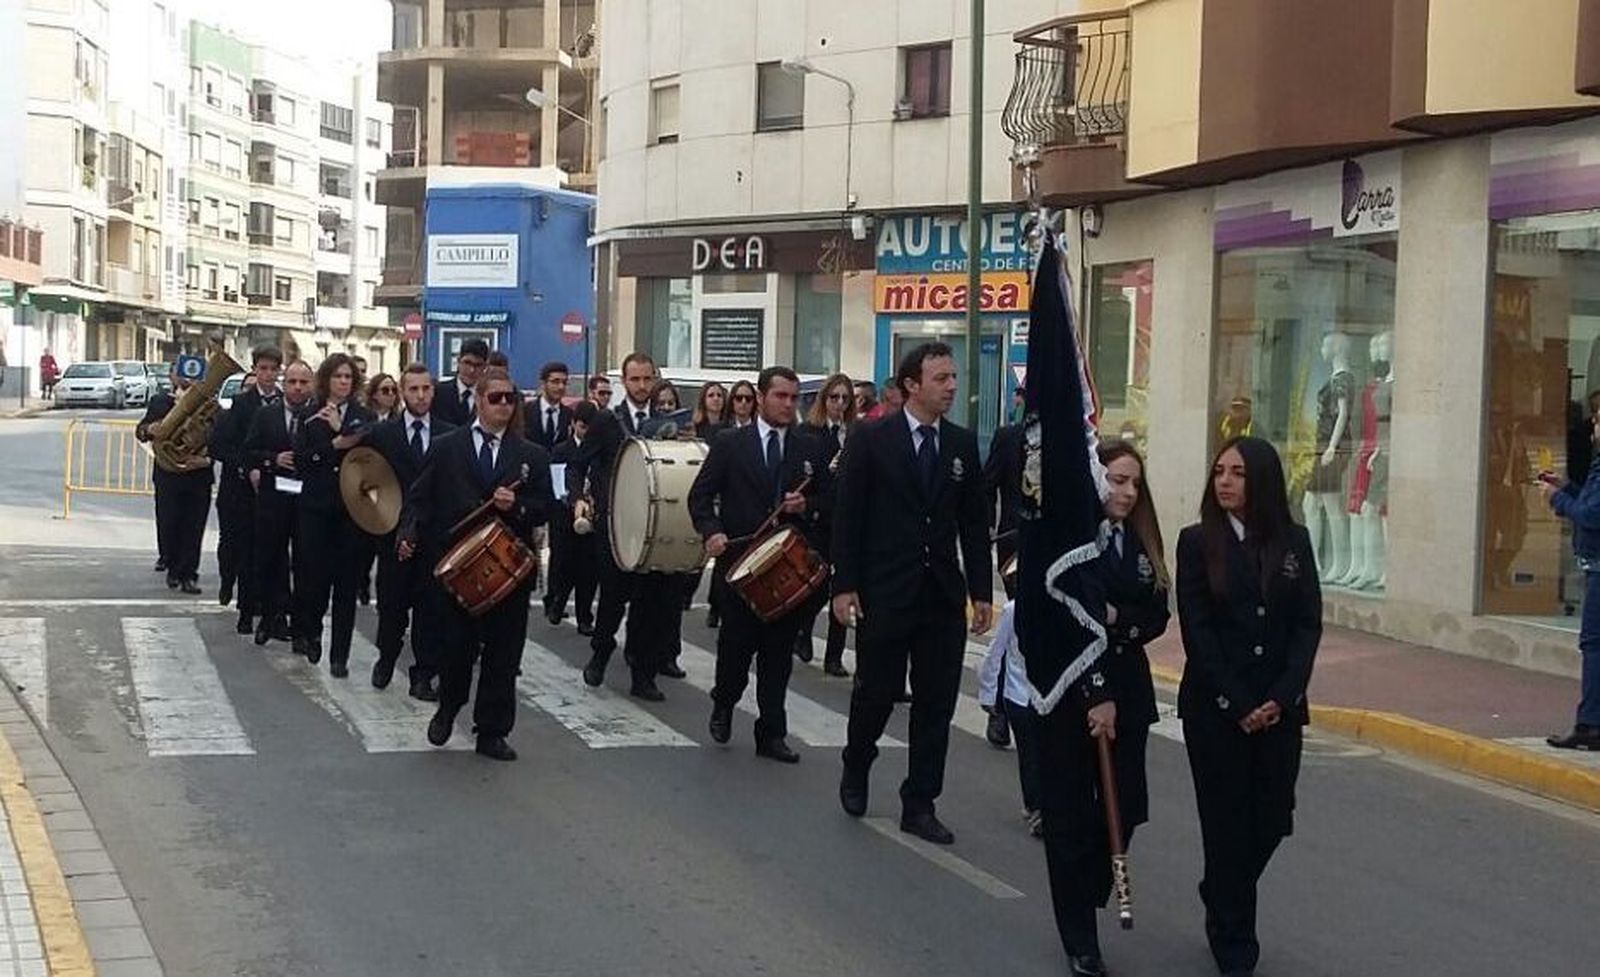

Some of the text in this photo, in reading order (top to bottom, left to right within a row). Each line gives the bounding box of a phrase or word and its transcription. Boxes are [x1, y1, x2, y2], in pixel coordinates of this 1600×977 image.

[436, 247, 510, 262] CAMPILLO
[995, 257, 1015, 271] DE
[883, 276, 1020, 311] micasa
